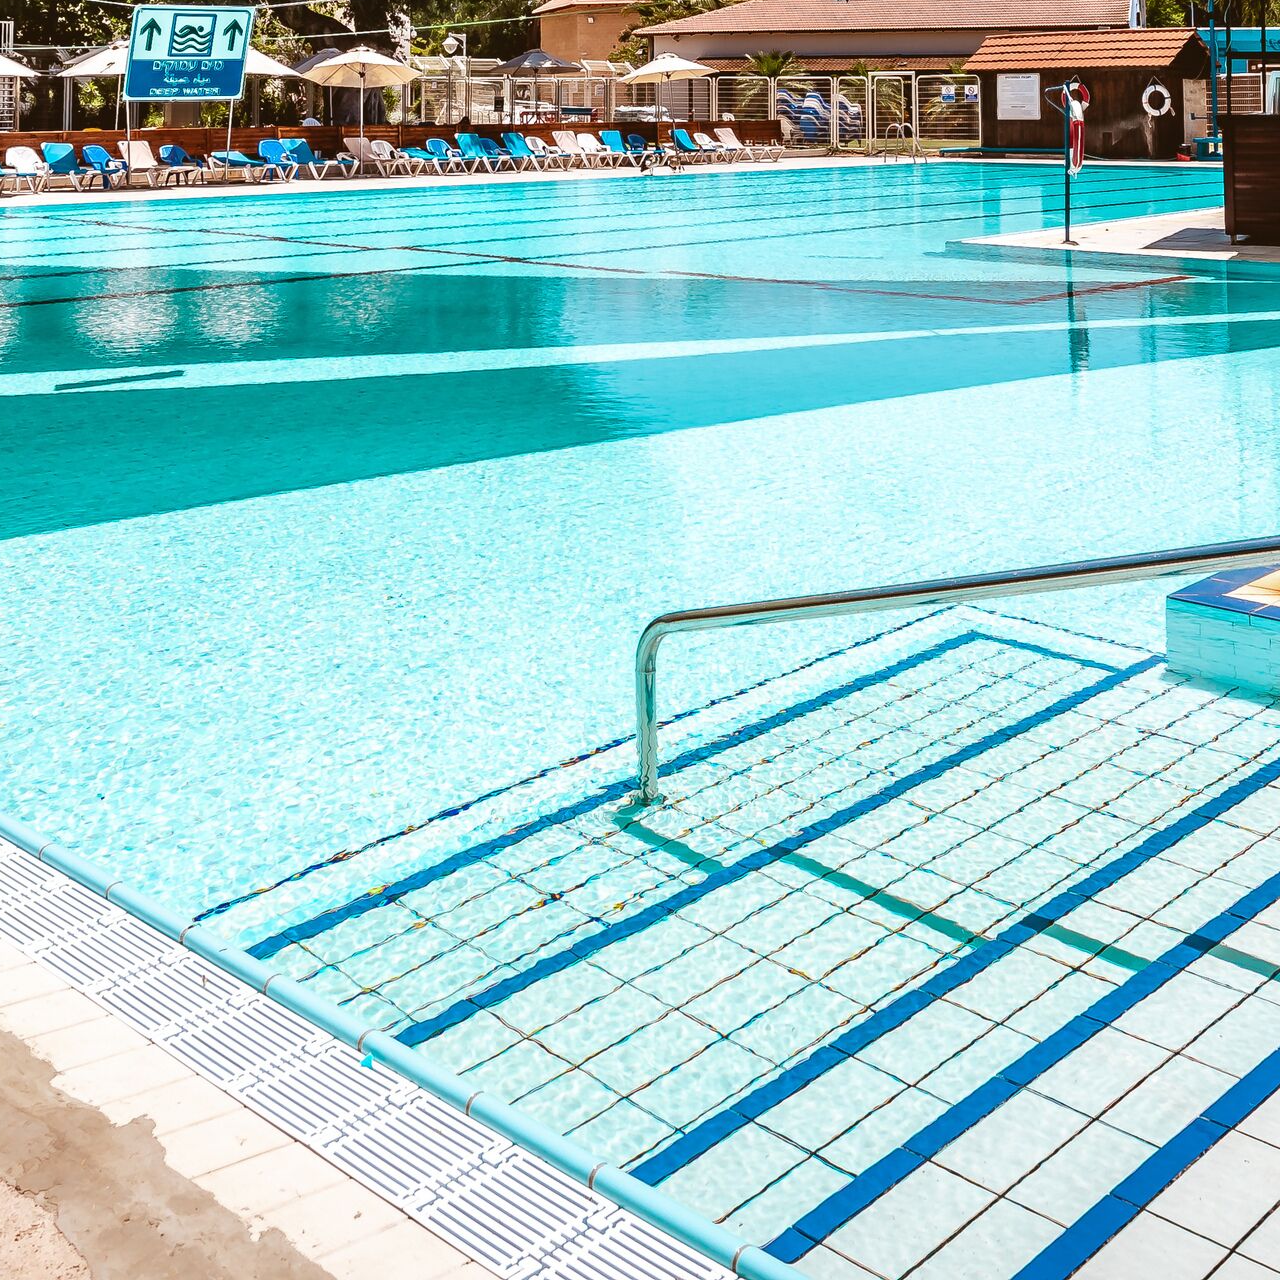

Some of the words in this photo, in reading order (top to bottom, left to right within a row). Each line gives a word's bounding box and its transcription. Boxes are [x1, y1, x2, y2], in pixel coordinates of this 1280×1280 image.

[153, 60, 198, 75] עמוקים
[201, 60, 224, 71] מים
[149, 87, 179, 96] DEEP
[182, 87, 221, 96] WATER
